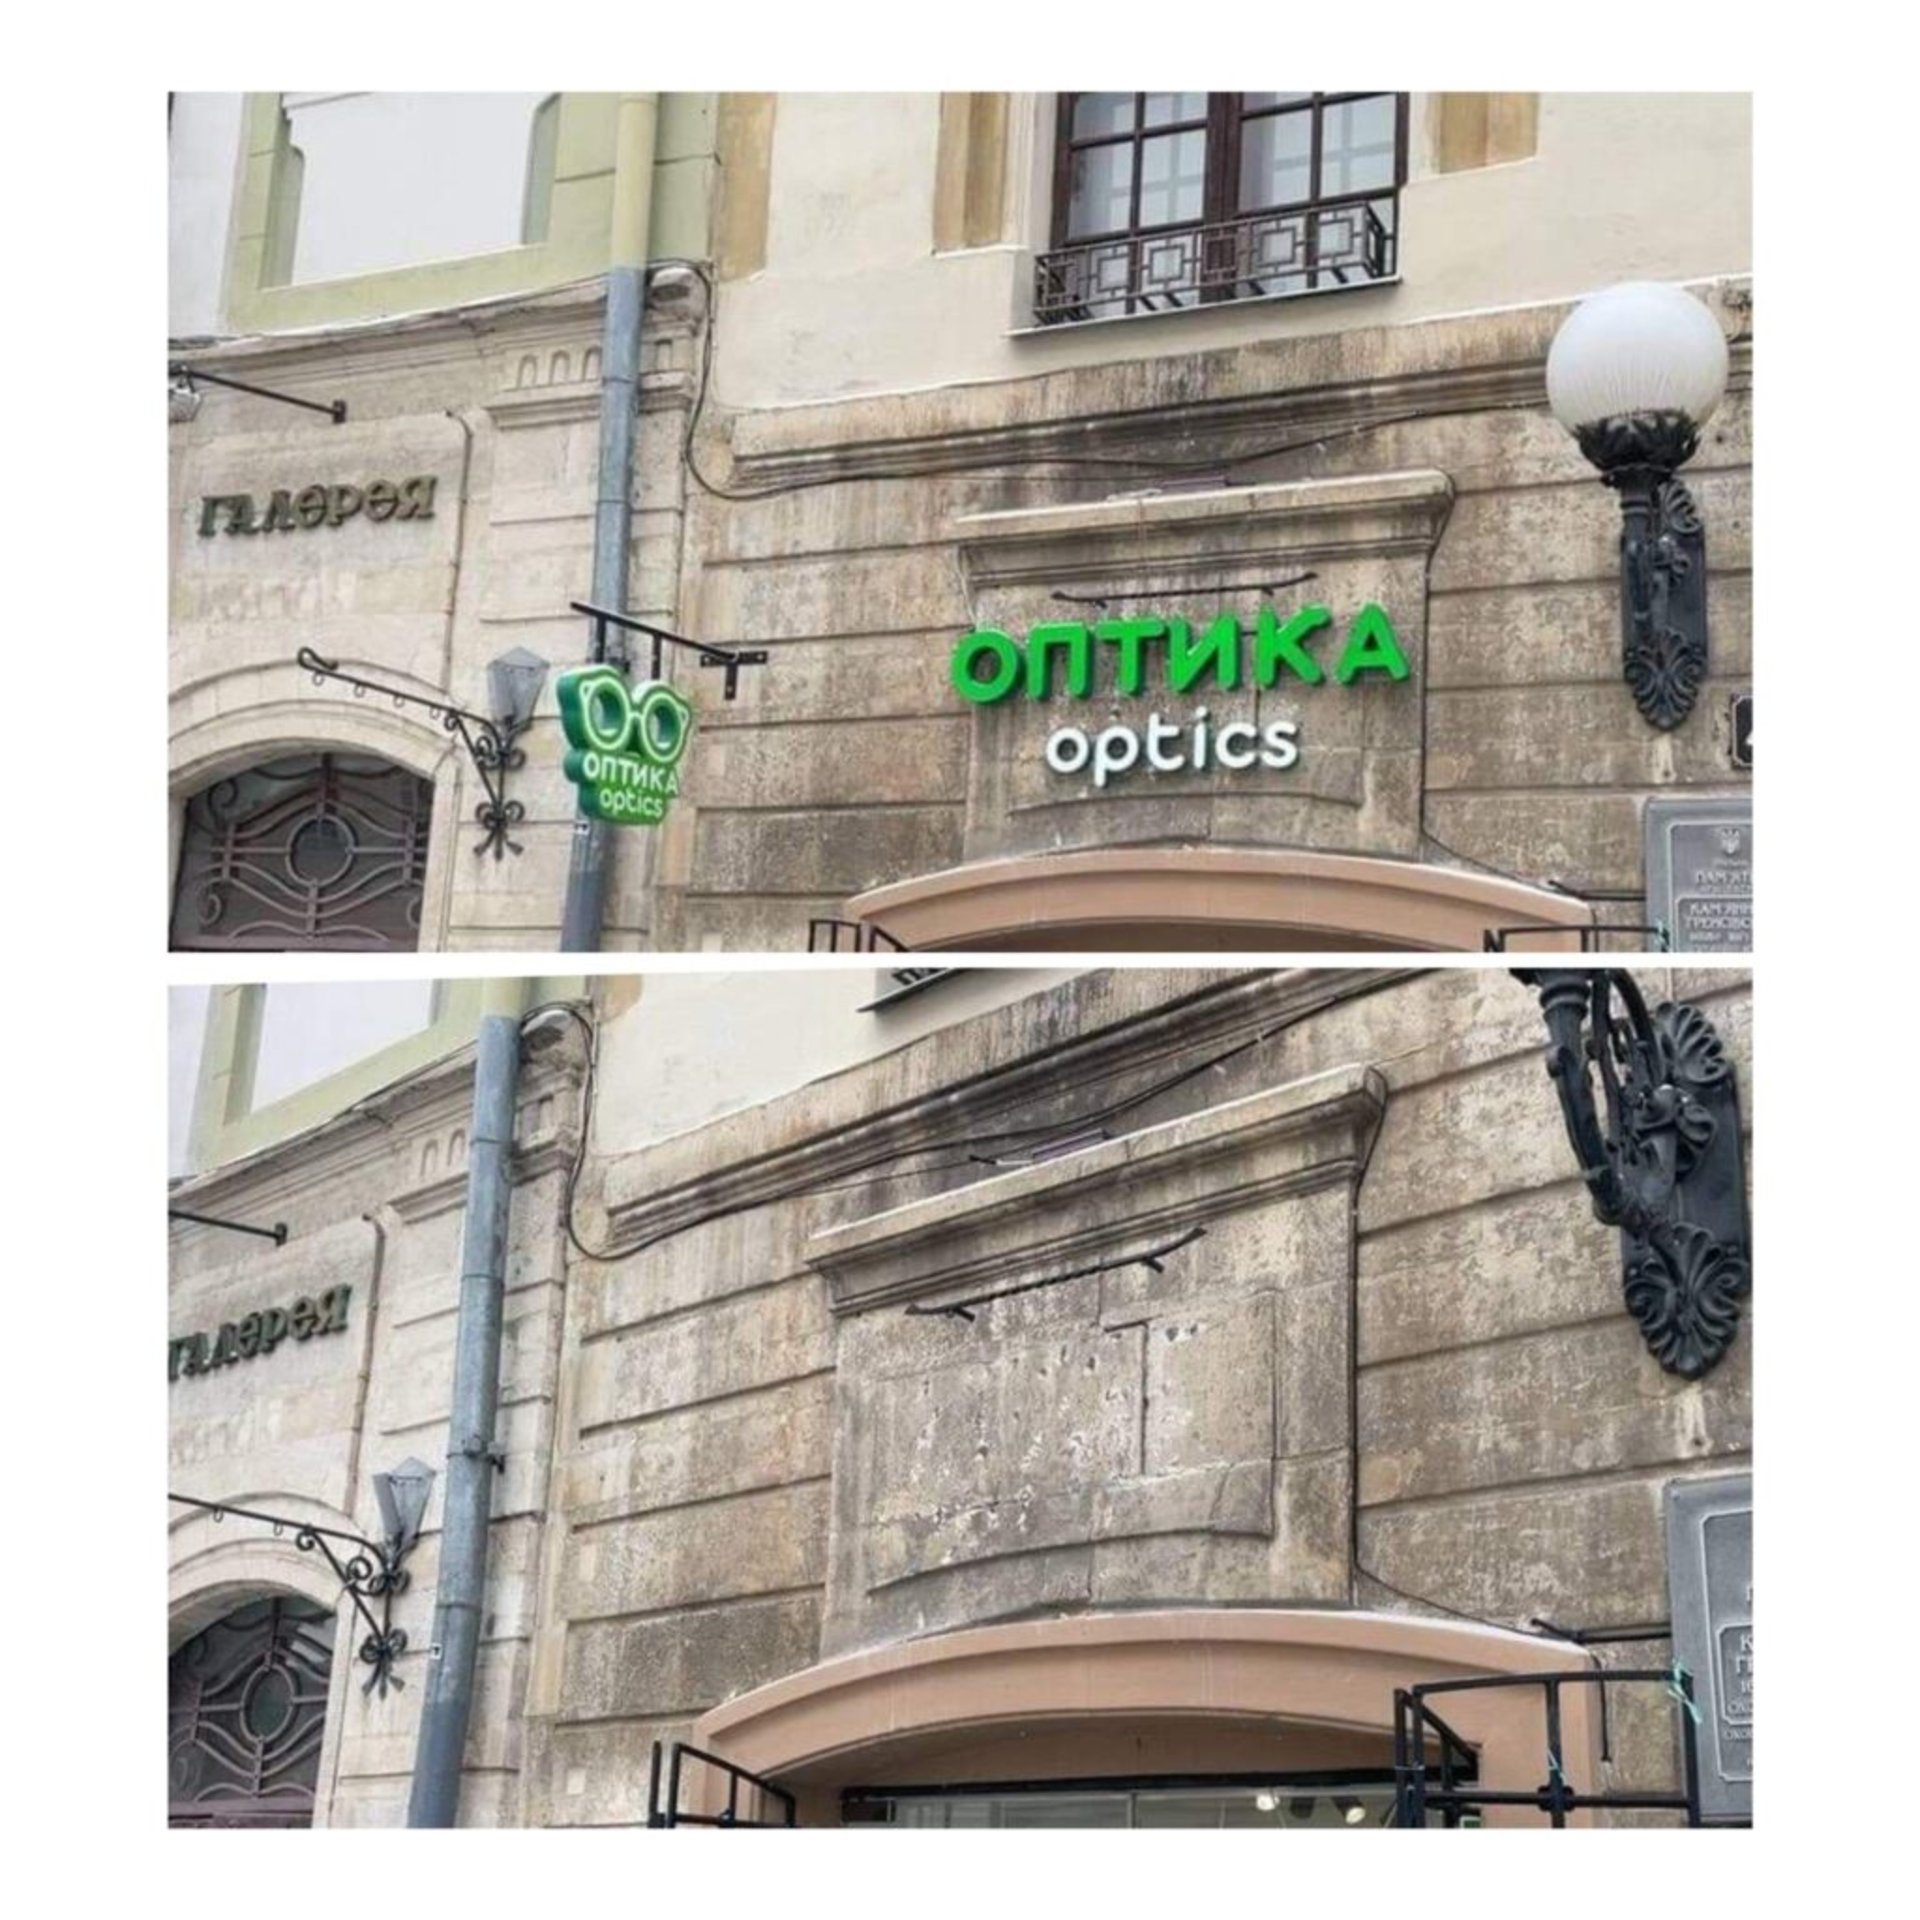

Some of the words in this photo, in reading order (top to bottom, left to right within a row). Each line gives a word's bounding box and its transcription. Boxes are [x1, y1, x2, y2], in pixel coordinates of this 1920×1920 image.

[951, 602, 1409, 702] ОПТИКА
[583, 752, 678, 794] ОПТИКА
[1046, 706, 1298, 787] optics
[600, 788, 662, 819] optics
